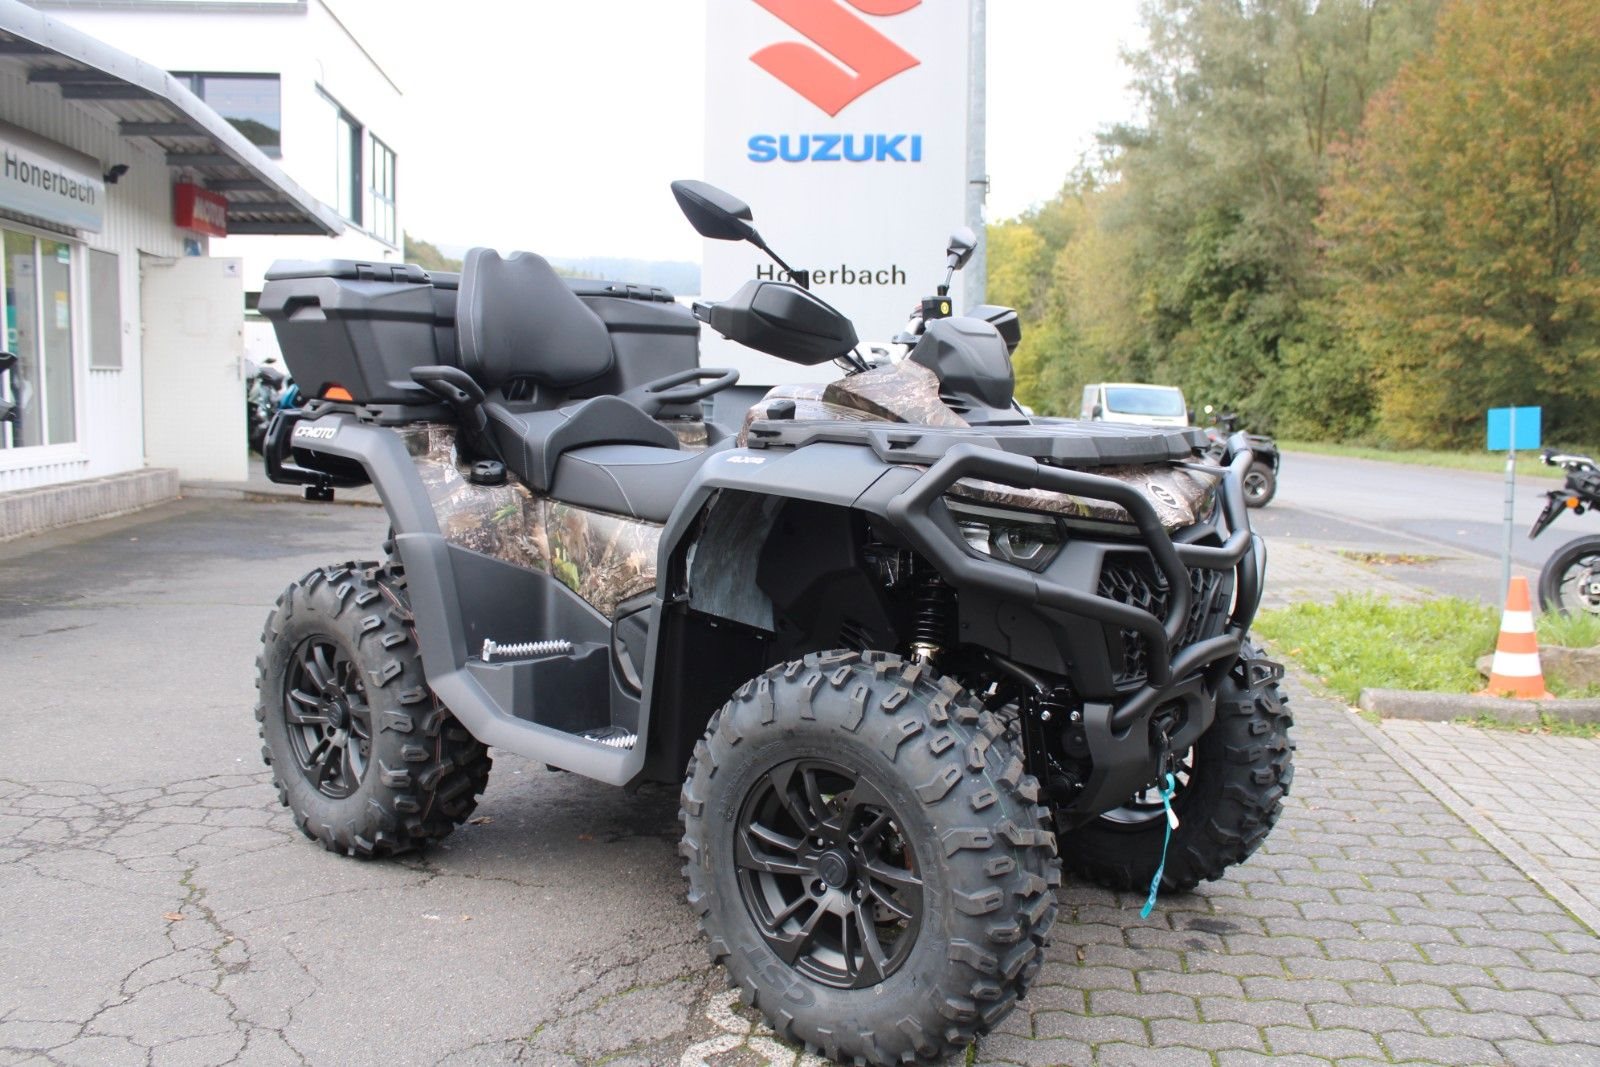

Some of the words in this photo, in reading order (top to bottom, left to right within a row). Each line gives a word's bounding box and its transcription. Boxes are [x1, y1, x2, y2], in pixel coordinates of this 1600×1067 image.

[747, 134, 922, 162] SUZUKI
[5, 150, 95, 205] Honerbach
[756, 264, 906, 285] Hoerbach
